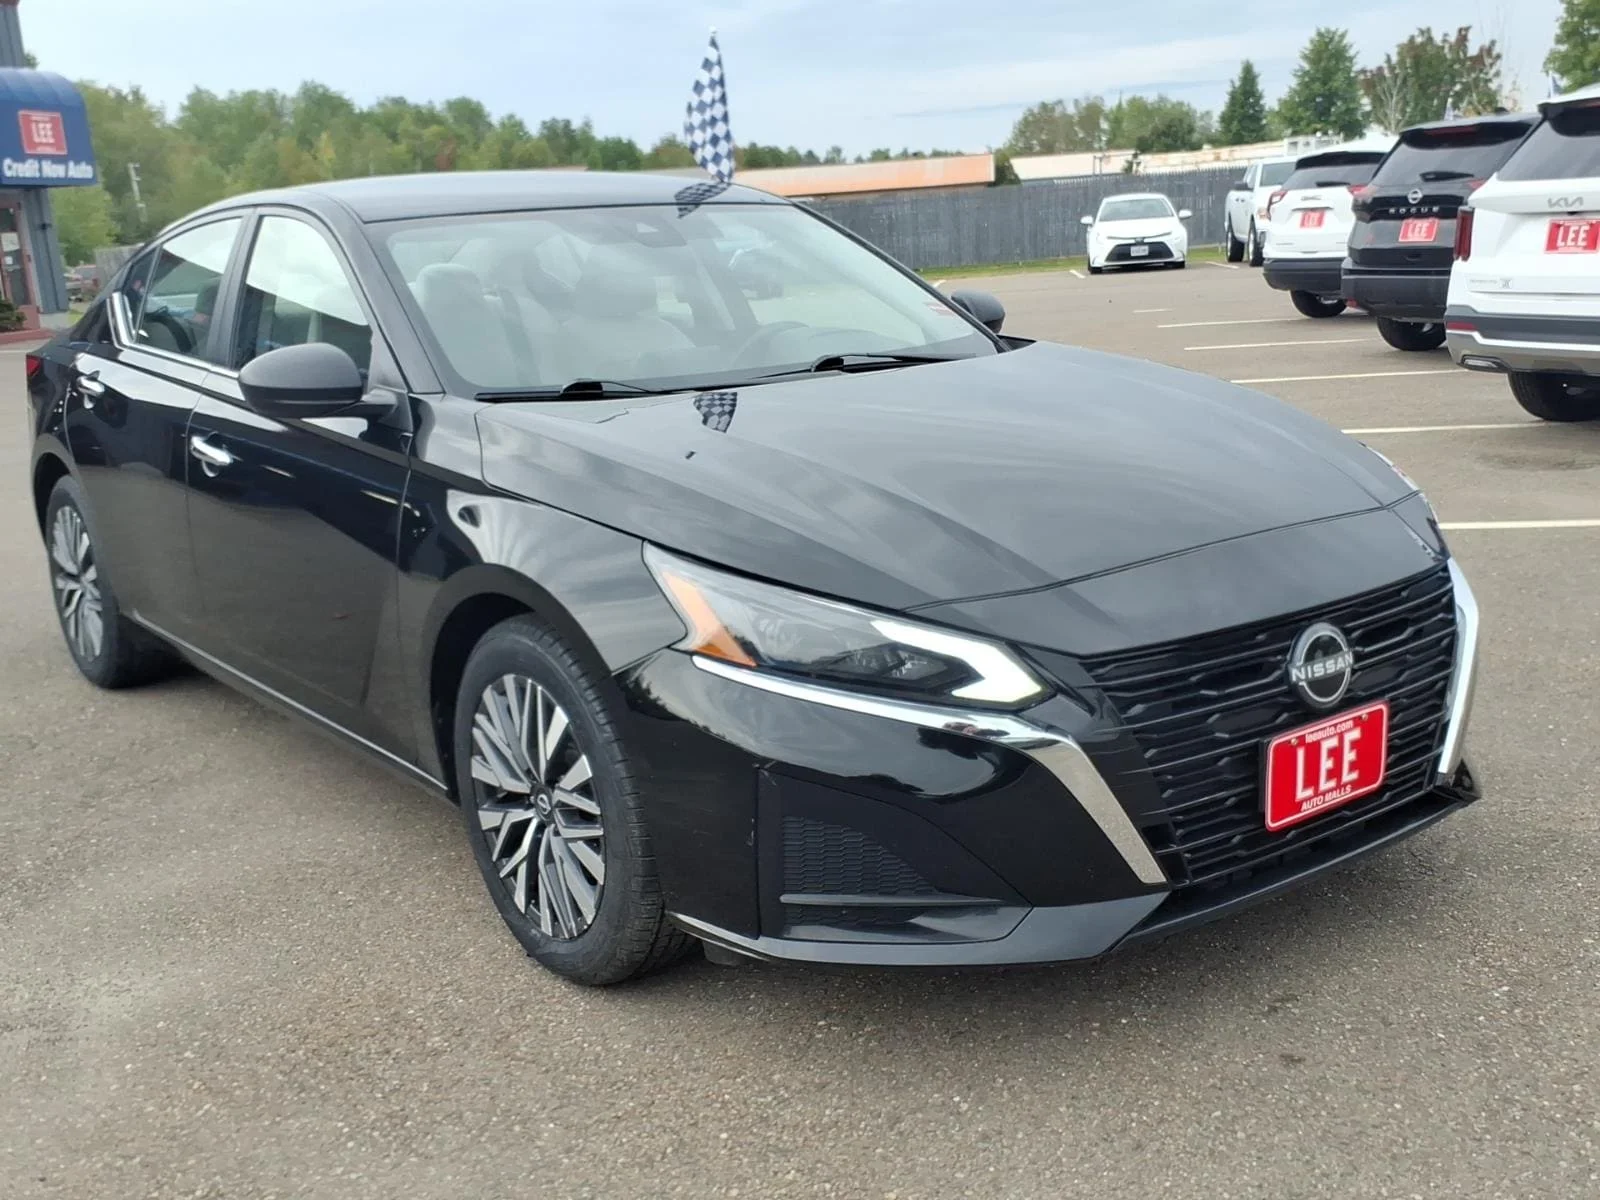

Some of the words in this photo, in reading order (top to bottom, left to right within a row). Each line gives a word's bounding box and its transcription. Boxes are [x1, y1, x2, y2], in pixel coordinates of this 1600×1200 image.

[31, 121, 55, 143] LEE
[1407, 223, 1430, 238] LEE
[1556, 225, 1590, 247] LEE
[1292, 651, 1353, 682] NISSAN
[1305, 719, 1354, 744] leeauto.com
[1295, 726, 1362, 802] LEE
[1300, 795, 1324, 812] AUTO
[1324, 784, 1352, 802] MALLS
